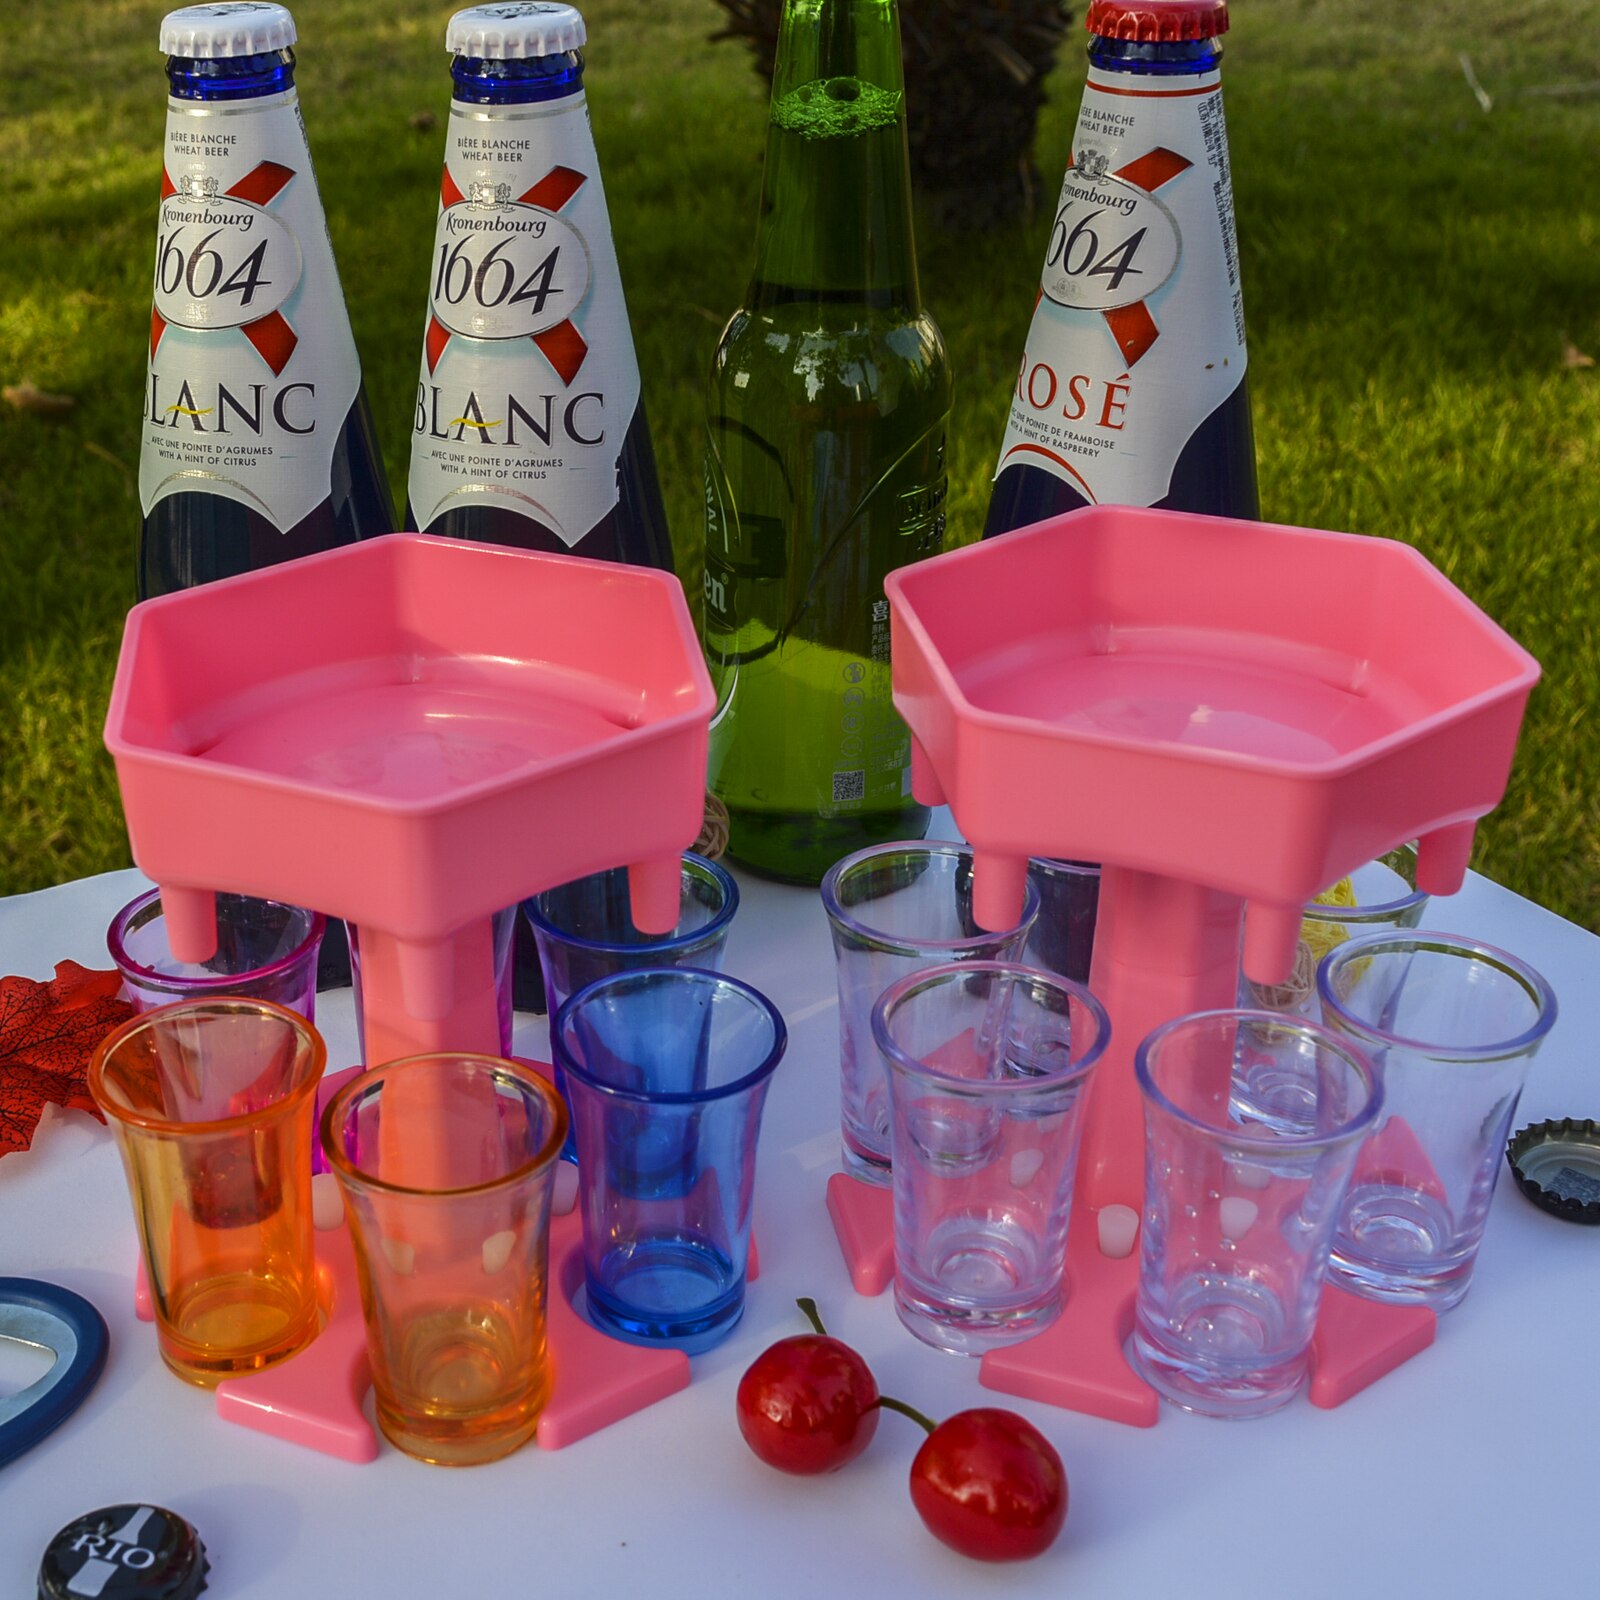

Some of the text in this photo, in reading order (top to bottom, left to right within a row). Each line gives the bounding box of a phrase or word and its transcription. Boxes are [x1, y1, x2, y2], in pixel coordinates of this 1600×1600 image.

[1093, 109, 1136, 127] BLANCHE
[170, 130, 237, 145] BIÈRE BLANCHE
[1102, 124, 1126, 138] BEER
[174, 144, 230, 157] WHEAT BEER
[457, 135, 531, 150] BIÈRE BLANCHE
[462, 150, 523, 162] WHEAT BEER
[162, 204, 255, 232] Kronenbourg
[445, 212, 547, 239] Kronenbourg
[155, 225, 273, 307] 1664
[434, 234, 564, 315] 1664
[415, 381, 605, 447] BLANC
[1019, 426, 1023, 434] A
[1023, 428, 1039, 440] HINT
[1040, 434, 1051, 445] OF
[1052, 438, 1100, 458] RASPBERRY
[1026, 416, 1050, 433] POINTE
[1051, 426, 1062, 437] DE
[1064, 430, 1116, 450] FRAMBOISE
[151, 435, 273, 455] AVEC UNE POINTE D'AGRUMES
[158, 449, 257, 467] WITH A HINT OF CITRUS
[431, 450, 564, 468] AVEC UNE POINTE D'AGRUMES
[440, 463, 547, 480] WITH A HINT OF CITRUS
[71, 1533, 156, 1570] RIO
